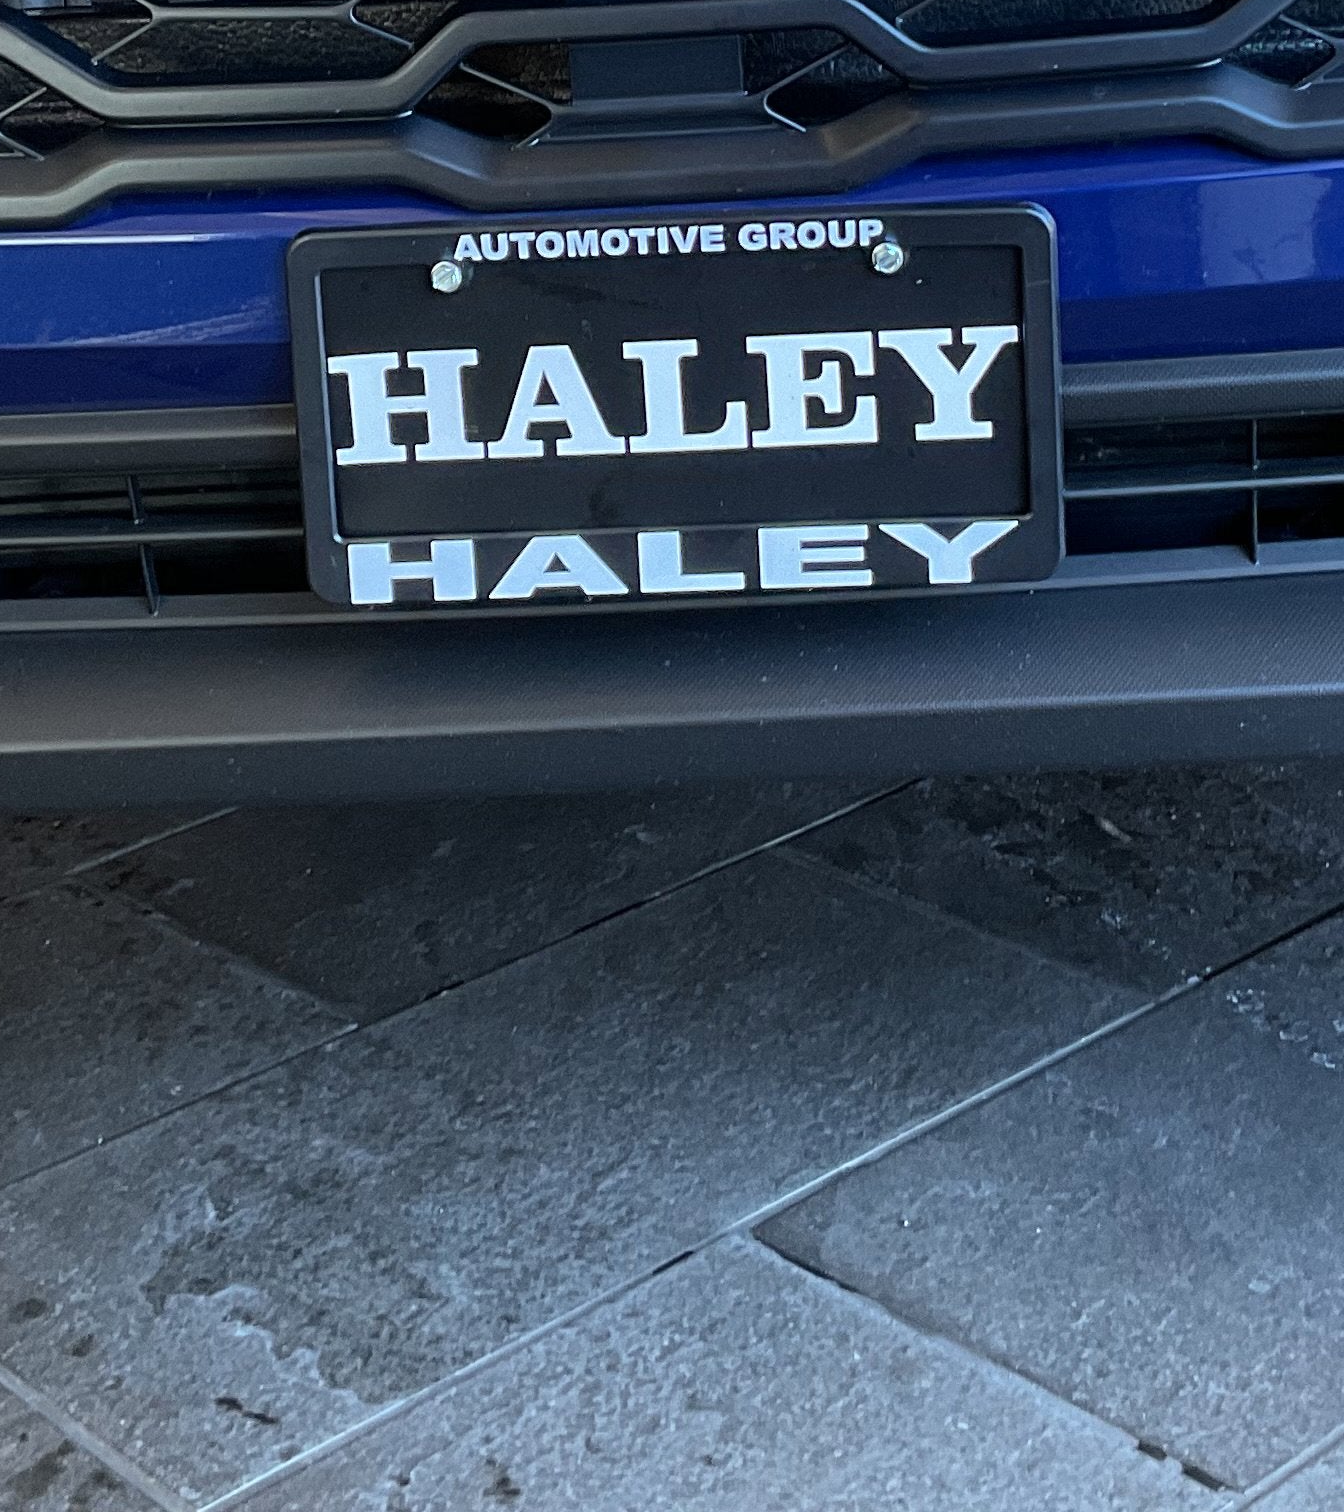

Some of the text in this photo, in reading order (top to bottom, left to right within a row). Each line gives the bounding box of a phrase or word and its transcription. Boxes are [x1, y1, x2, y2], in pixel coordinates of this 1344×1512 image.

[453, 219, 885, 262] AUTOMOTIVE GROUP
[327, 324, 1020, 466] HALEY
[347, 519, 1020, 605] HALEY
